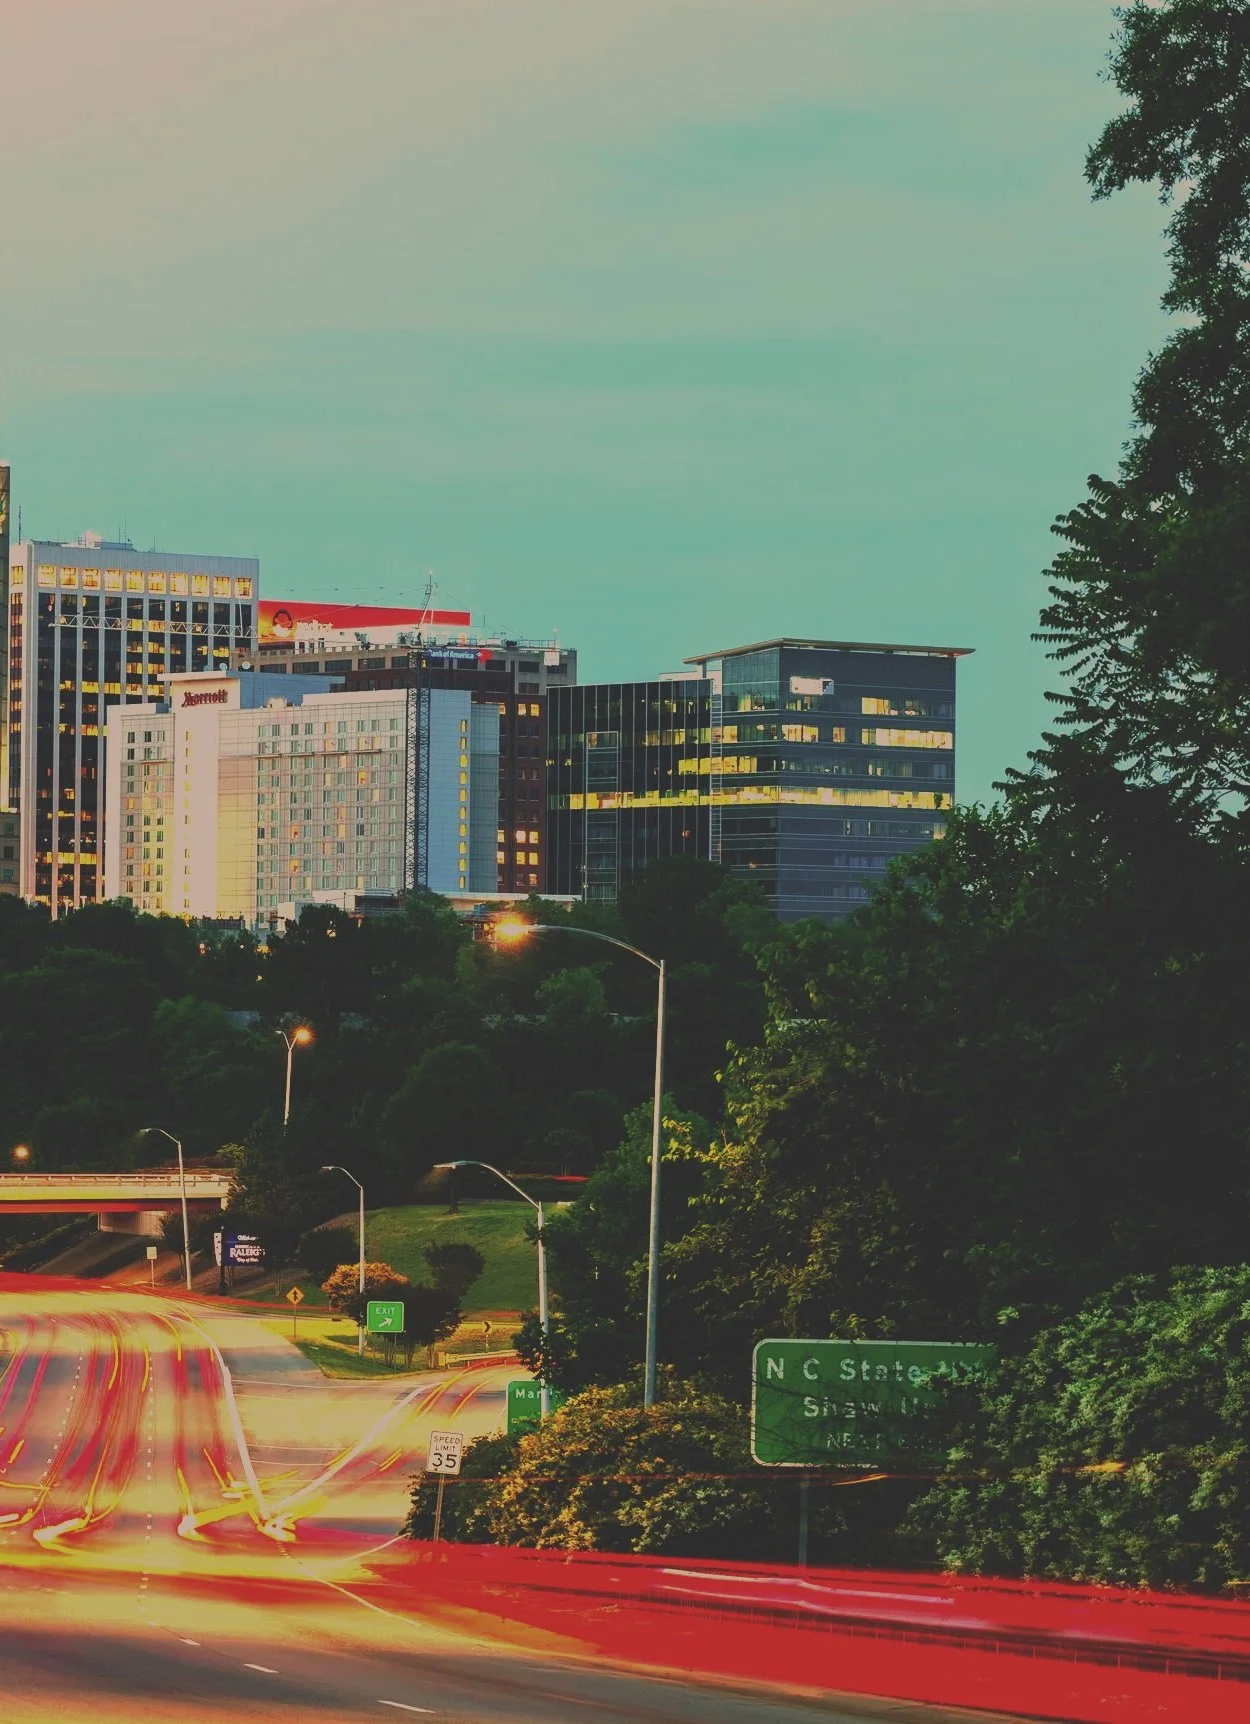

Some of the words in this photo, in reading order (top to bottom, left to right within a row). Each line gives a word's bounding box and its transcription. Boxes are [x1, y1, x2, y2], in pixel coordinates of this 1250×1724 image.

[375, 1307, 395, 1315] EXIT
[766, 1357, 784, 1380] N
[803, 1357, 820, 1381] C
[839, 1357, 921, 1382] State
[433, 1435, 460, 1444] SPEED
[435, 1444, 456, 1452] LIMIT
[432, 1452, 457, 1469] 35
